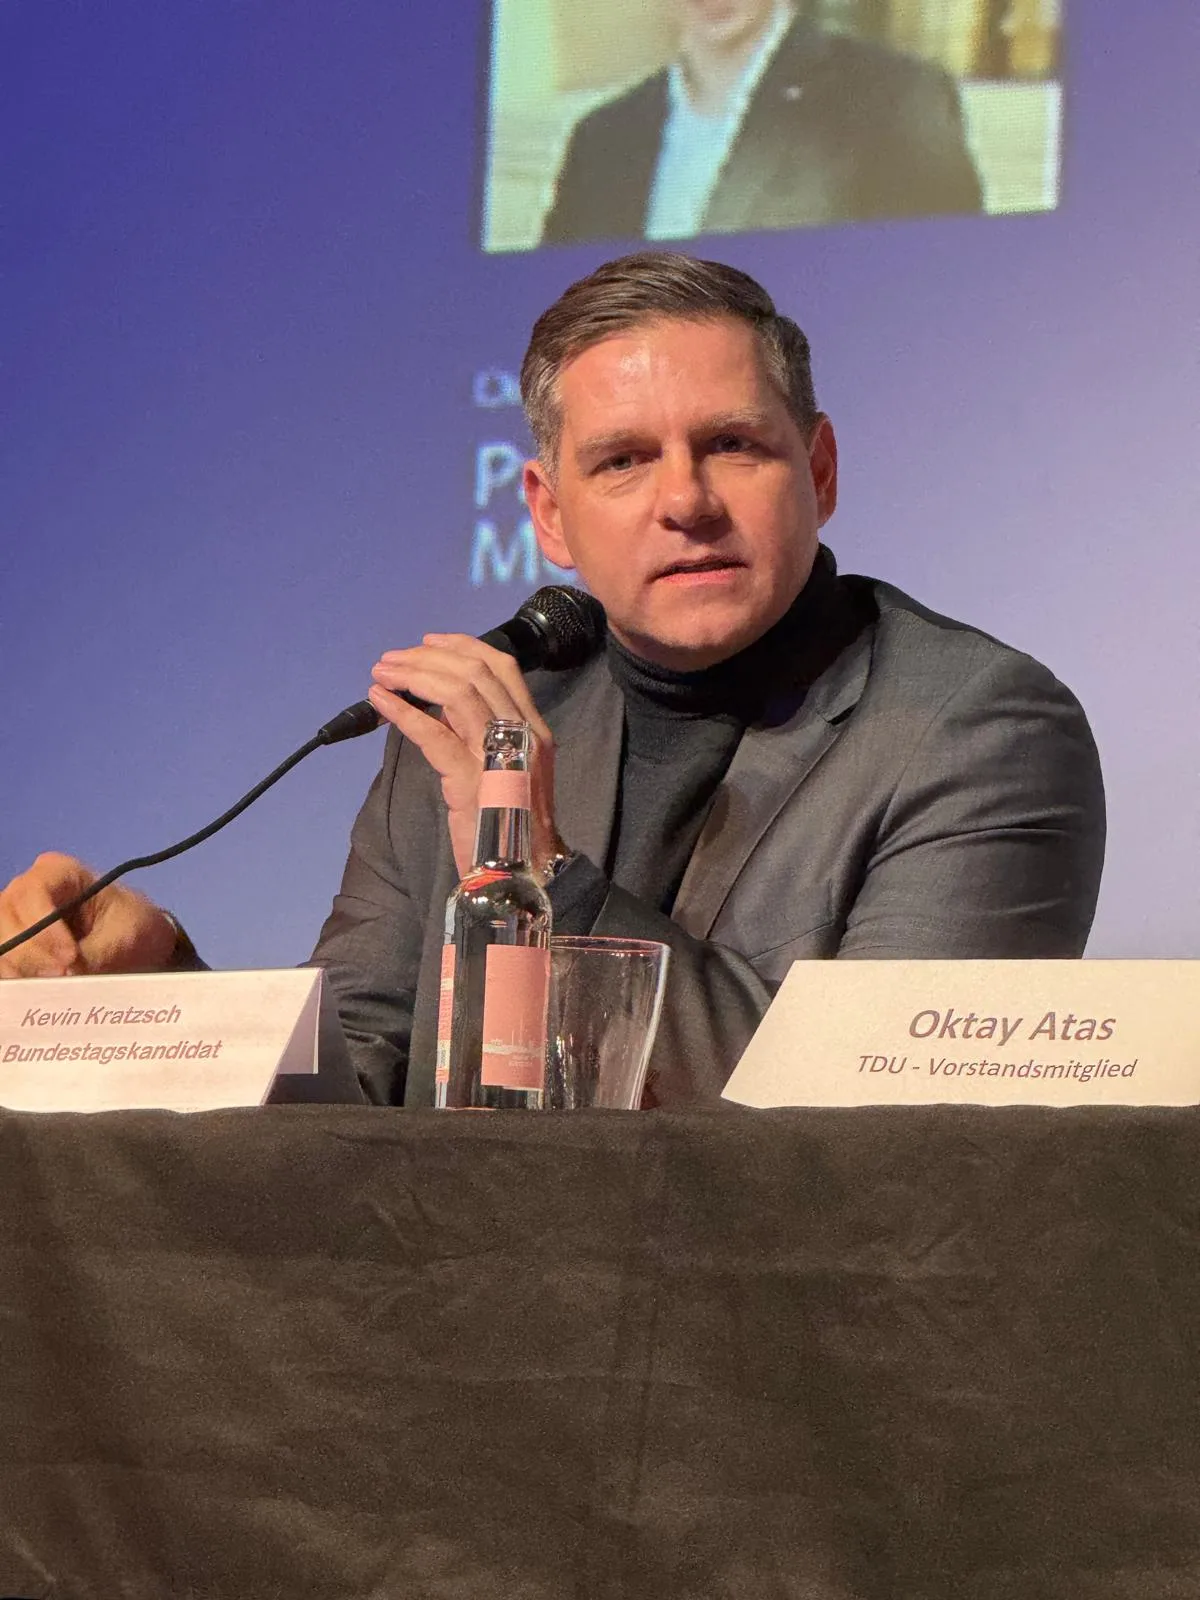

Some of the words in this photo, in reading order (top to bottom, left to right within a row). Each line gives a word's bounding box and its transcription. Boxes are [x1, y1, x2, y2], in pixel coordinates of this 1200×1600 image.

[21, 1007, 81, 1028] Kevin
[84, 1005, 182, 1025] Kratzsch
[908, 1008, 1023, 1046] Oktay
[1028, 1011, 1116, 1041] Atas
[2, 1039, 222, 1065] Bundestagskandidat
[857, 1056, 907, 1074] TDU
[929, 1058, 1138, 1083] Vorstandsmitglied
